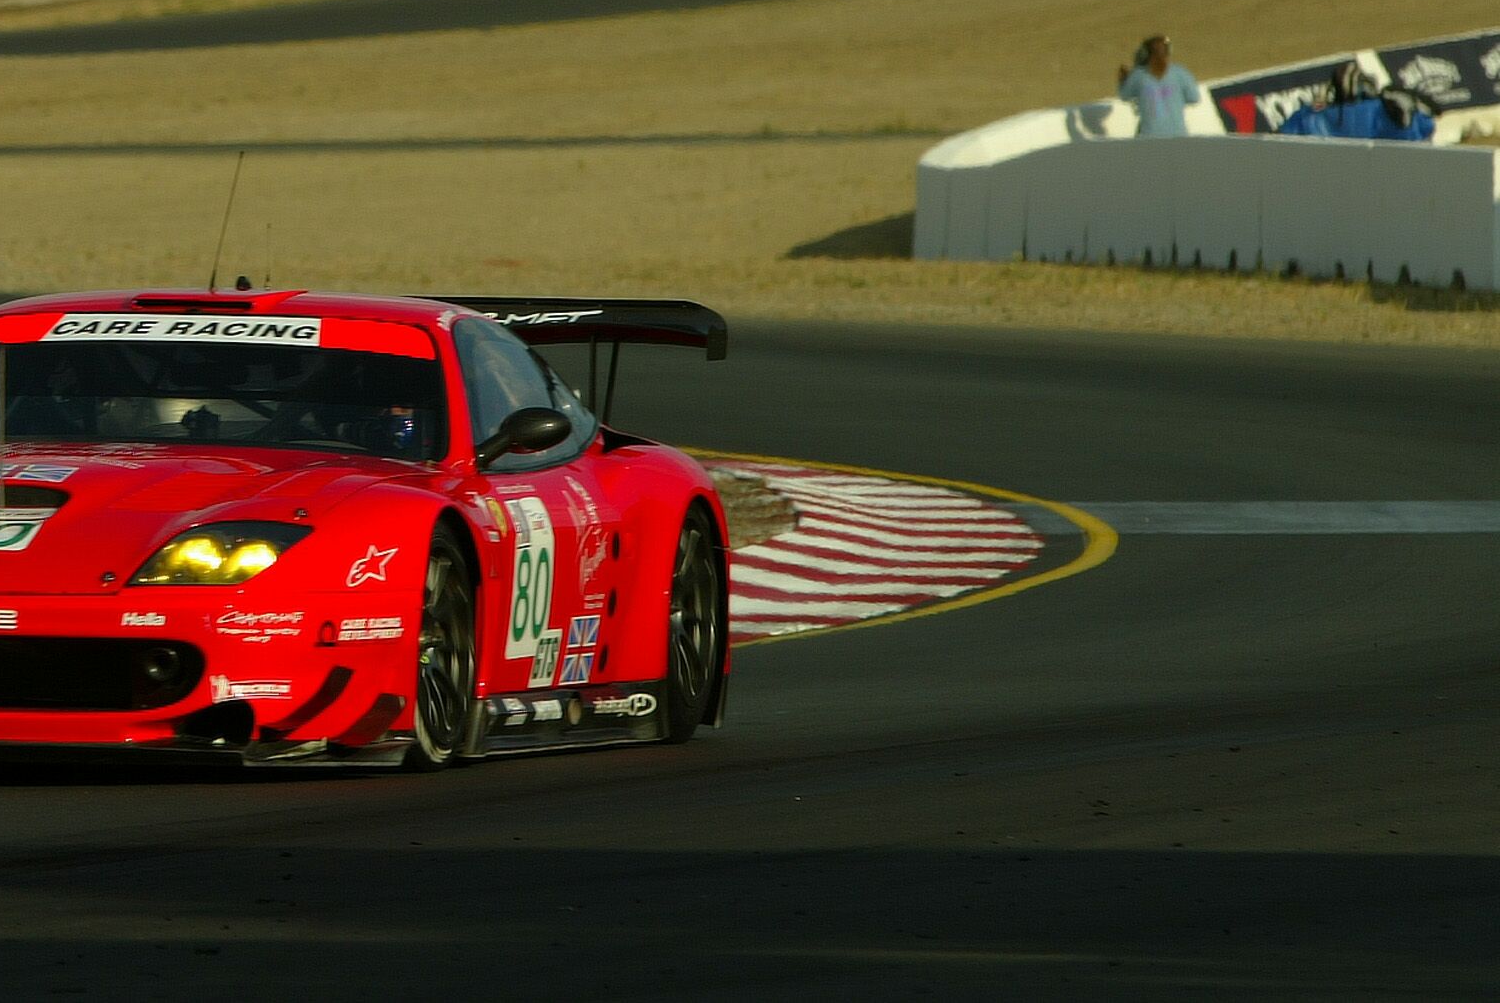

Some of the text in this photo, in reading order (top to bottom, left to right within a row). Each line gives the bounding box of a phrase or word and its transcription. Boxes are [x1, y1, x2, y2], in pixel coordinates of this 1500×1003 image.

[51, 320, 319, 340] CARE RACING
[512, 547, 550, 643] 80
[121, 612, 167, 627] Hella
